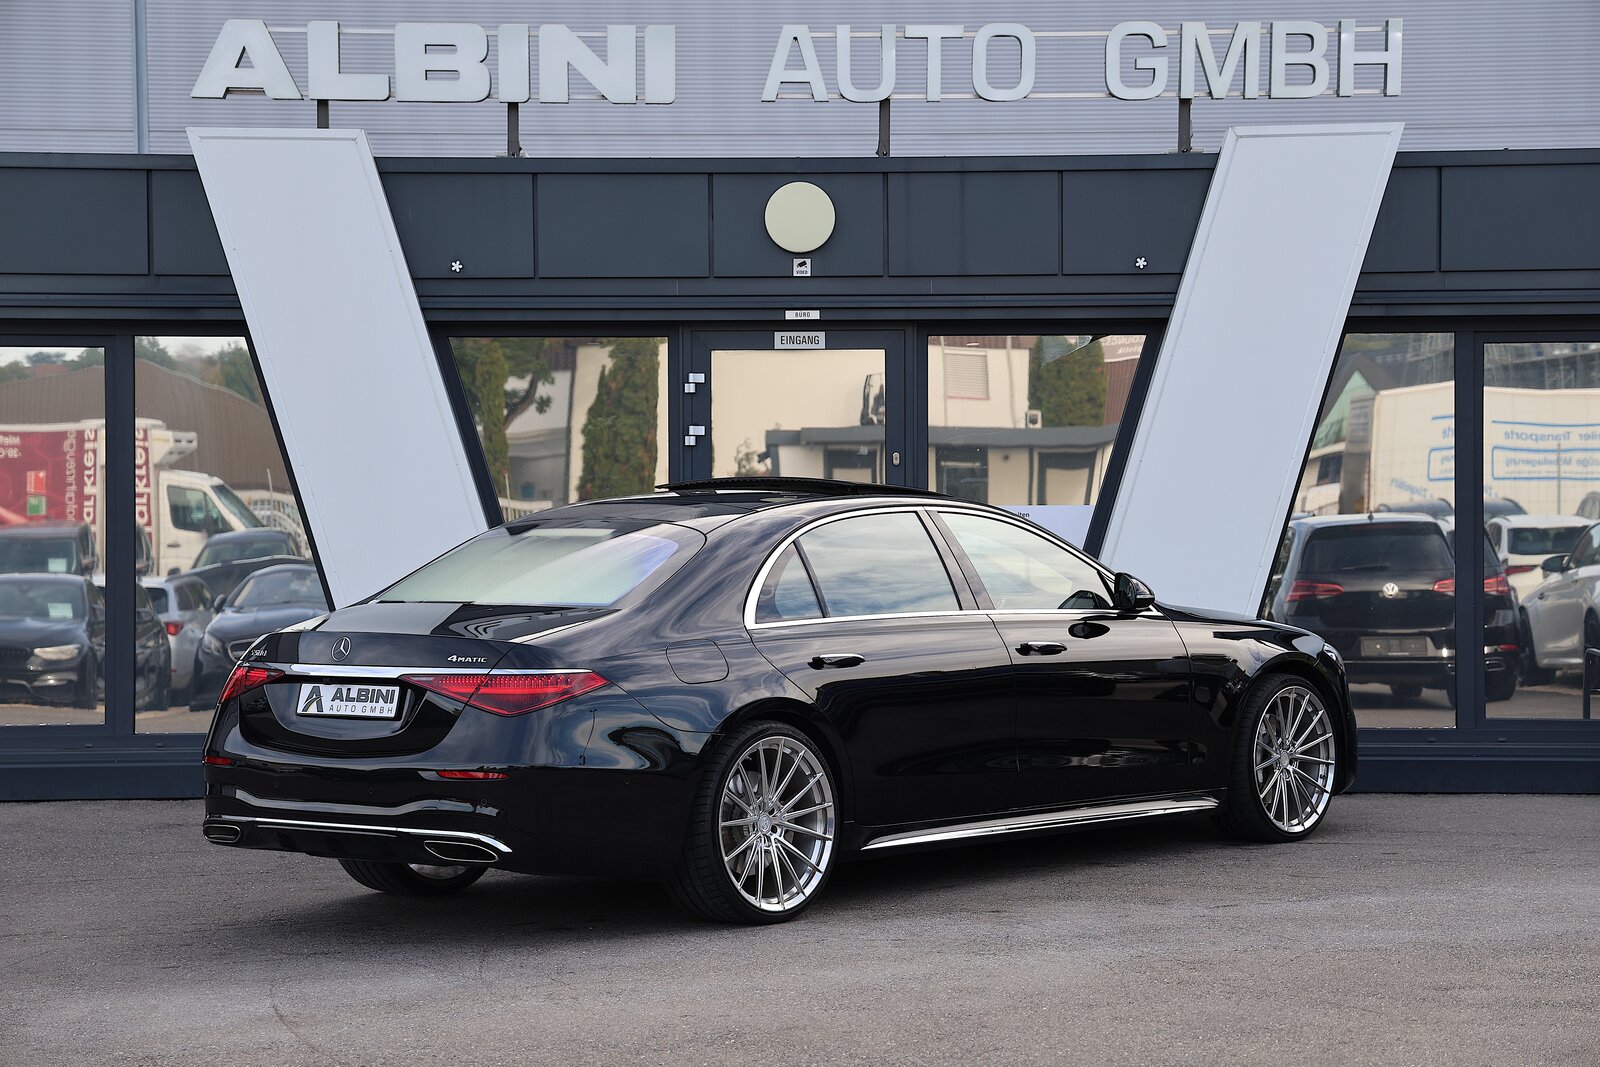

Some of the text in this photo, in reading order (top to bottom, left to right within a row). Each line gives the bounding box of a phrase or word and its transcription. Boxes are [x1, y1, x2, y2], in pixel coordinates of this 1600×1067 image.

[190, 18, 1403, 105] ALBINI AUTO GMBH
[780, 335, 820, 345] EINGANG
[447, 654, 488, 663] 4MATIC
[331, 687, 396, 704] ALBINI
[329, 704, 393, 715] AUTO GMBH
